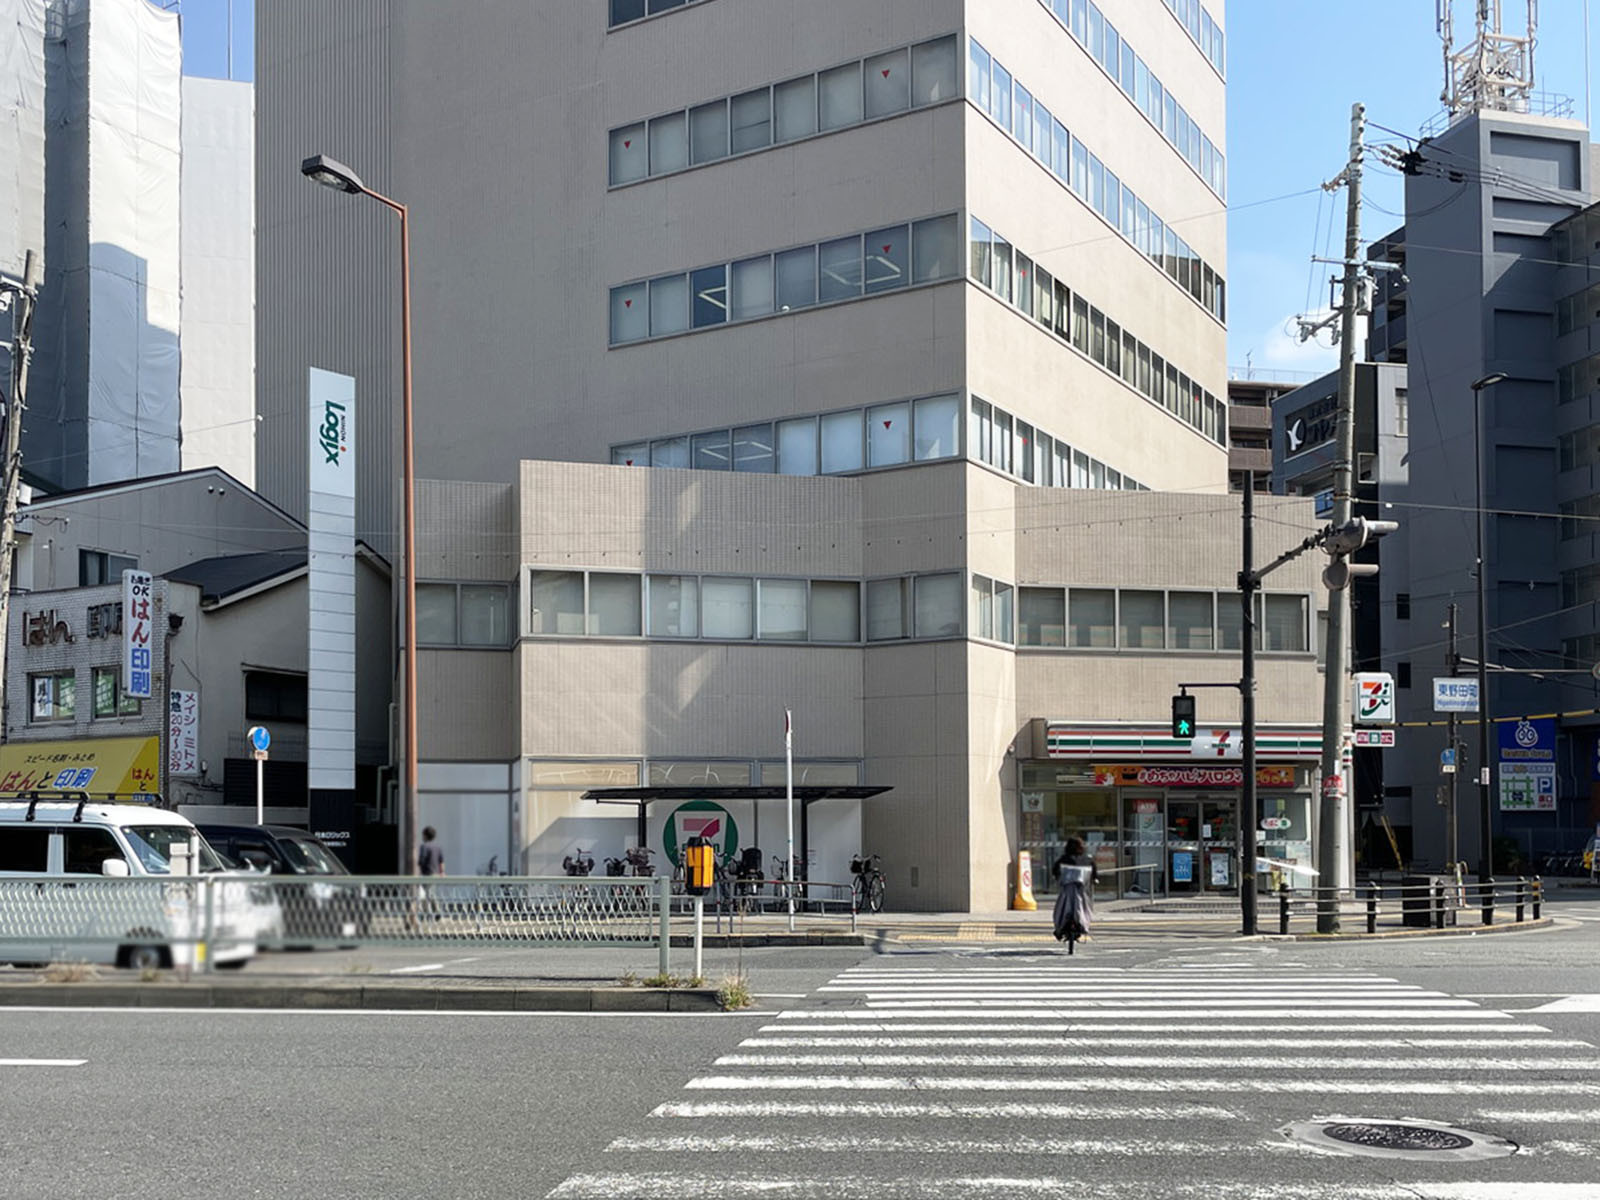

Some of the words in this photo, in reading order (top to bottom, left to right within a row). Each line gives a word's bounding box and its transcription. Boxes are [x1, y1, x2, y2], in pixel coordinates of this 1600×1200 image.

[319, 400, 346, 467] Logix
[132, 585, 149, 597] OK
[184, 693, 196, 771] メイシ・ミトメ
[132, 767, 155, 781] はん
[139, 781, 147, 791] と
[1540, 778, 1551, 793] P
